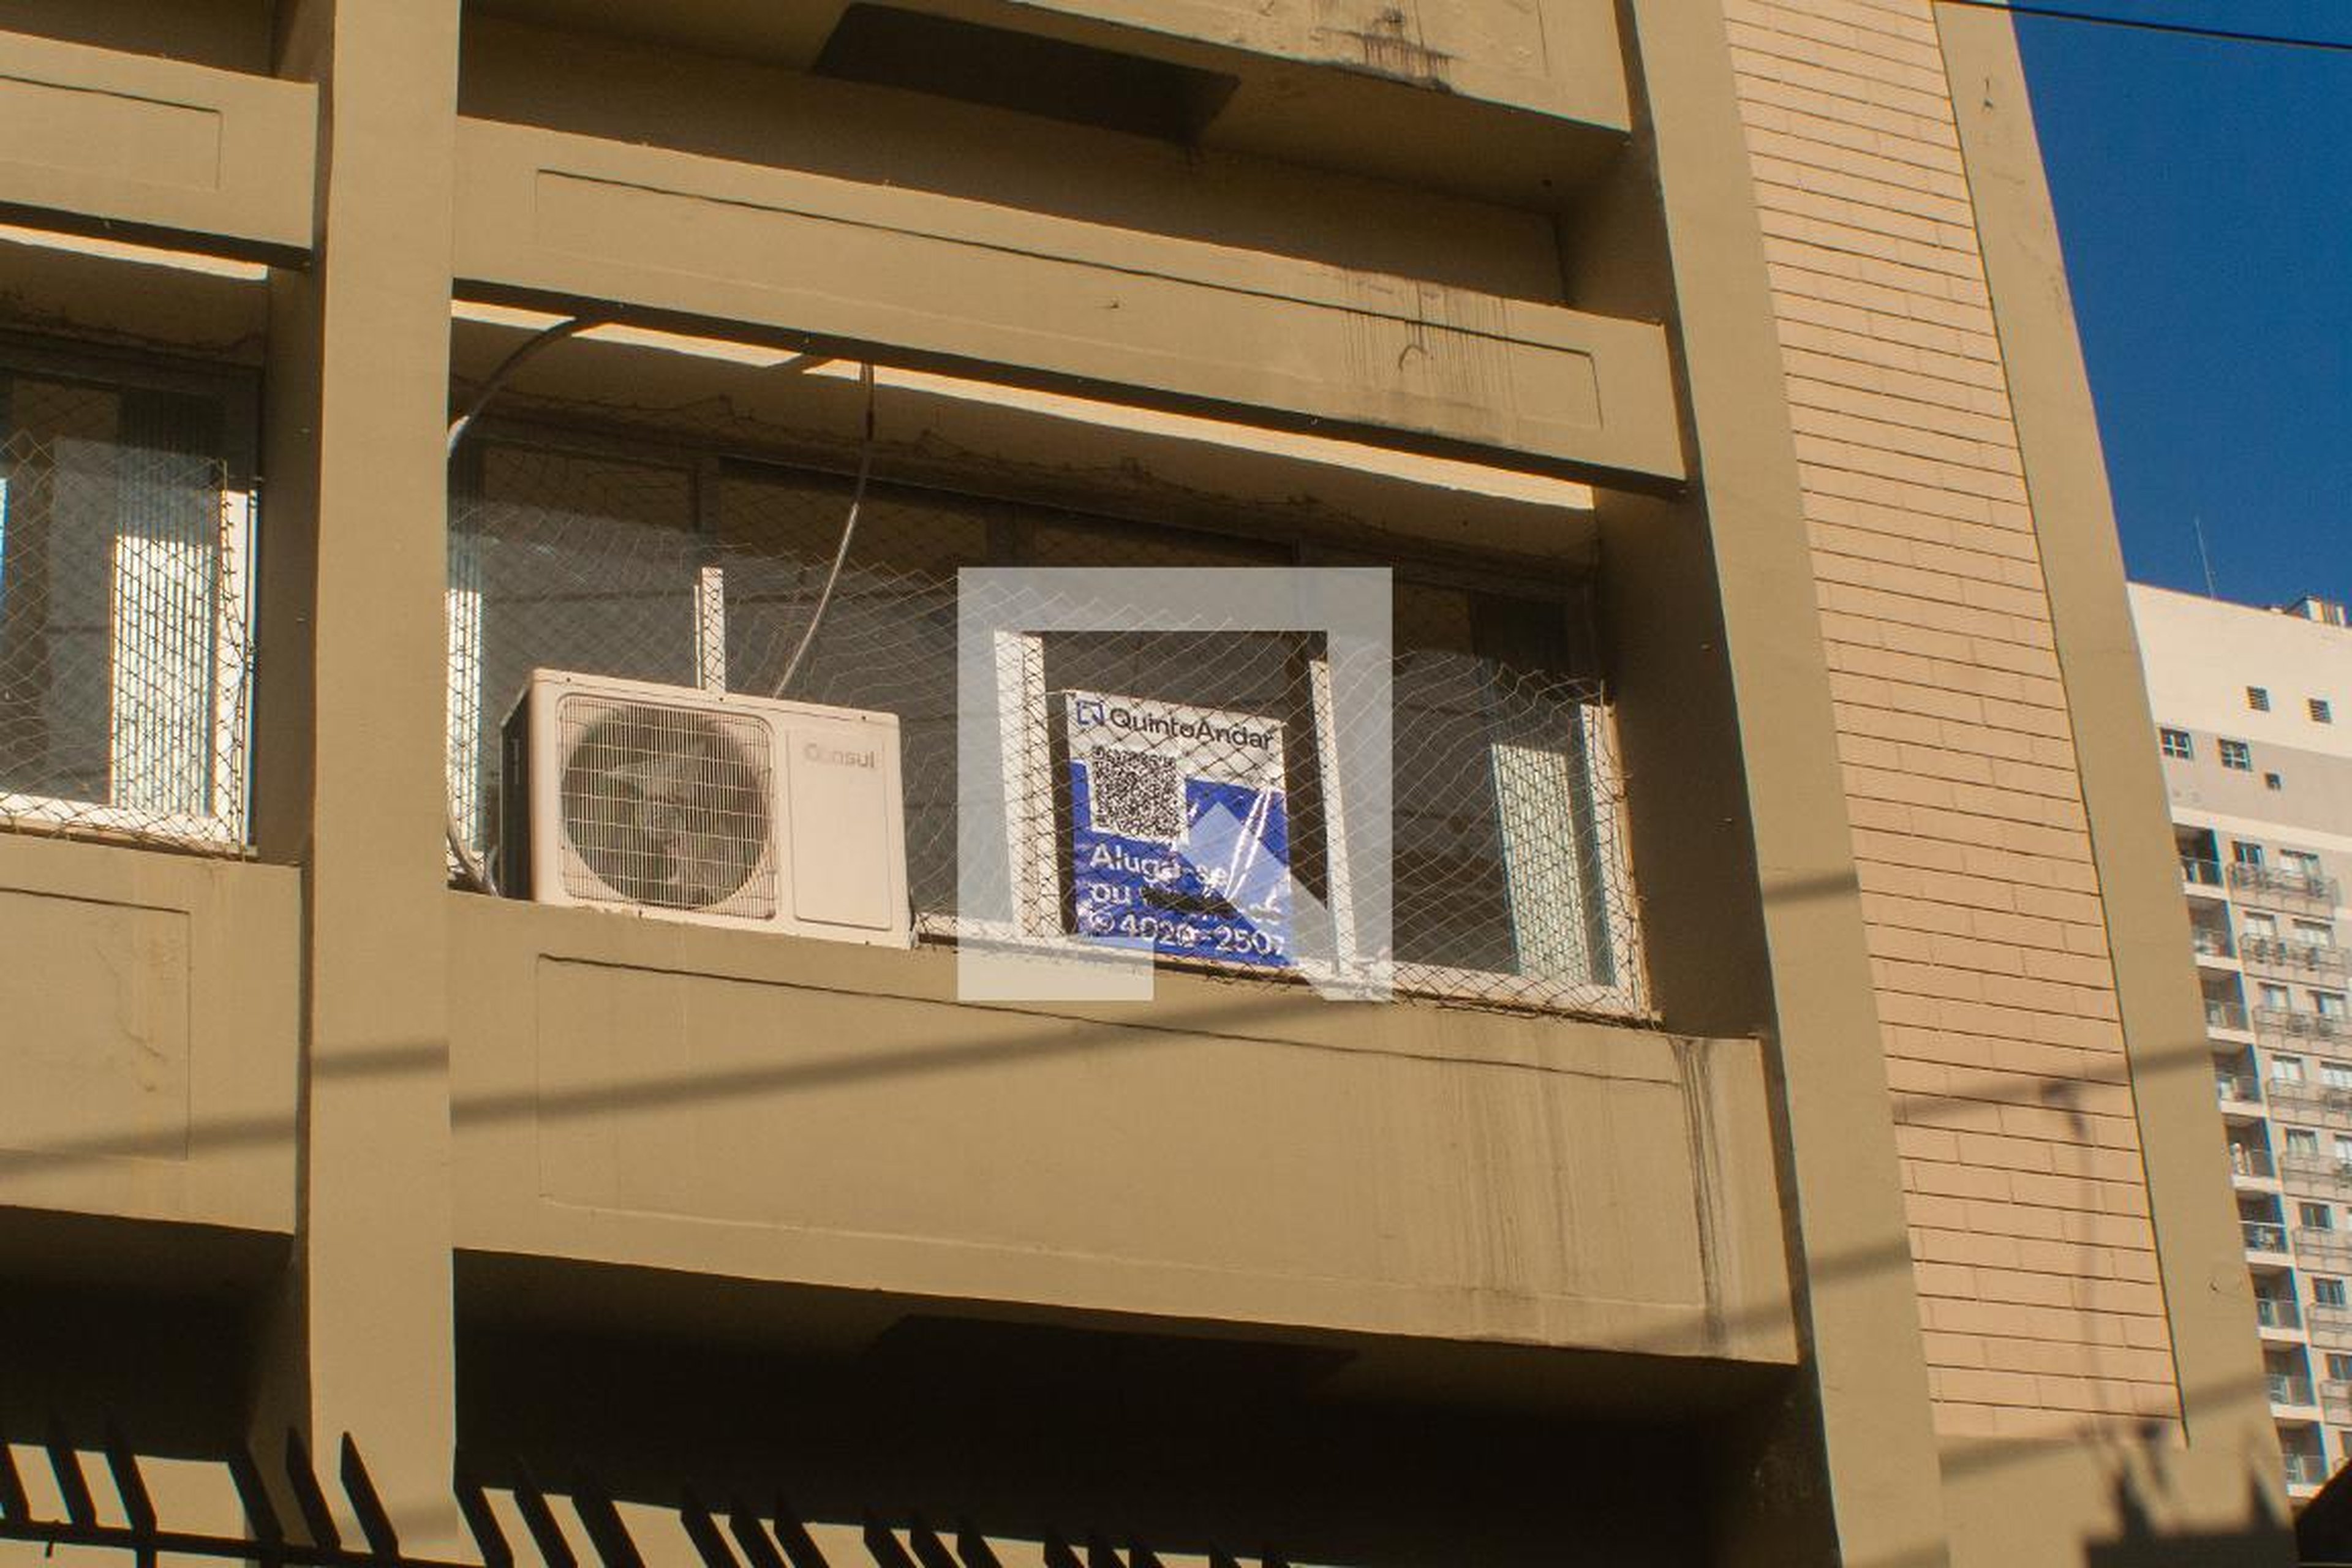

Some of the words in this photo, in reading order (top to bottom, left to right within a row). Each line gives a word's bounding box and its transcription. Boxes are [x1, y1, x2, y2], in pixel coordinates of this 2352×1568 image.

[1110, 708, 1273, 750] QuintoAndar
[803, 743, 875, 768] Cnsul
[1091, 884, 1131, 905] ou
